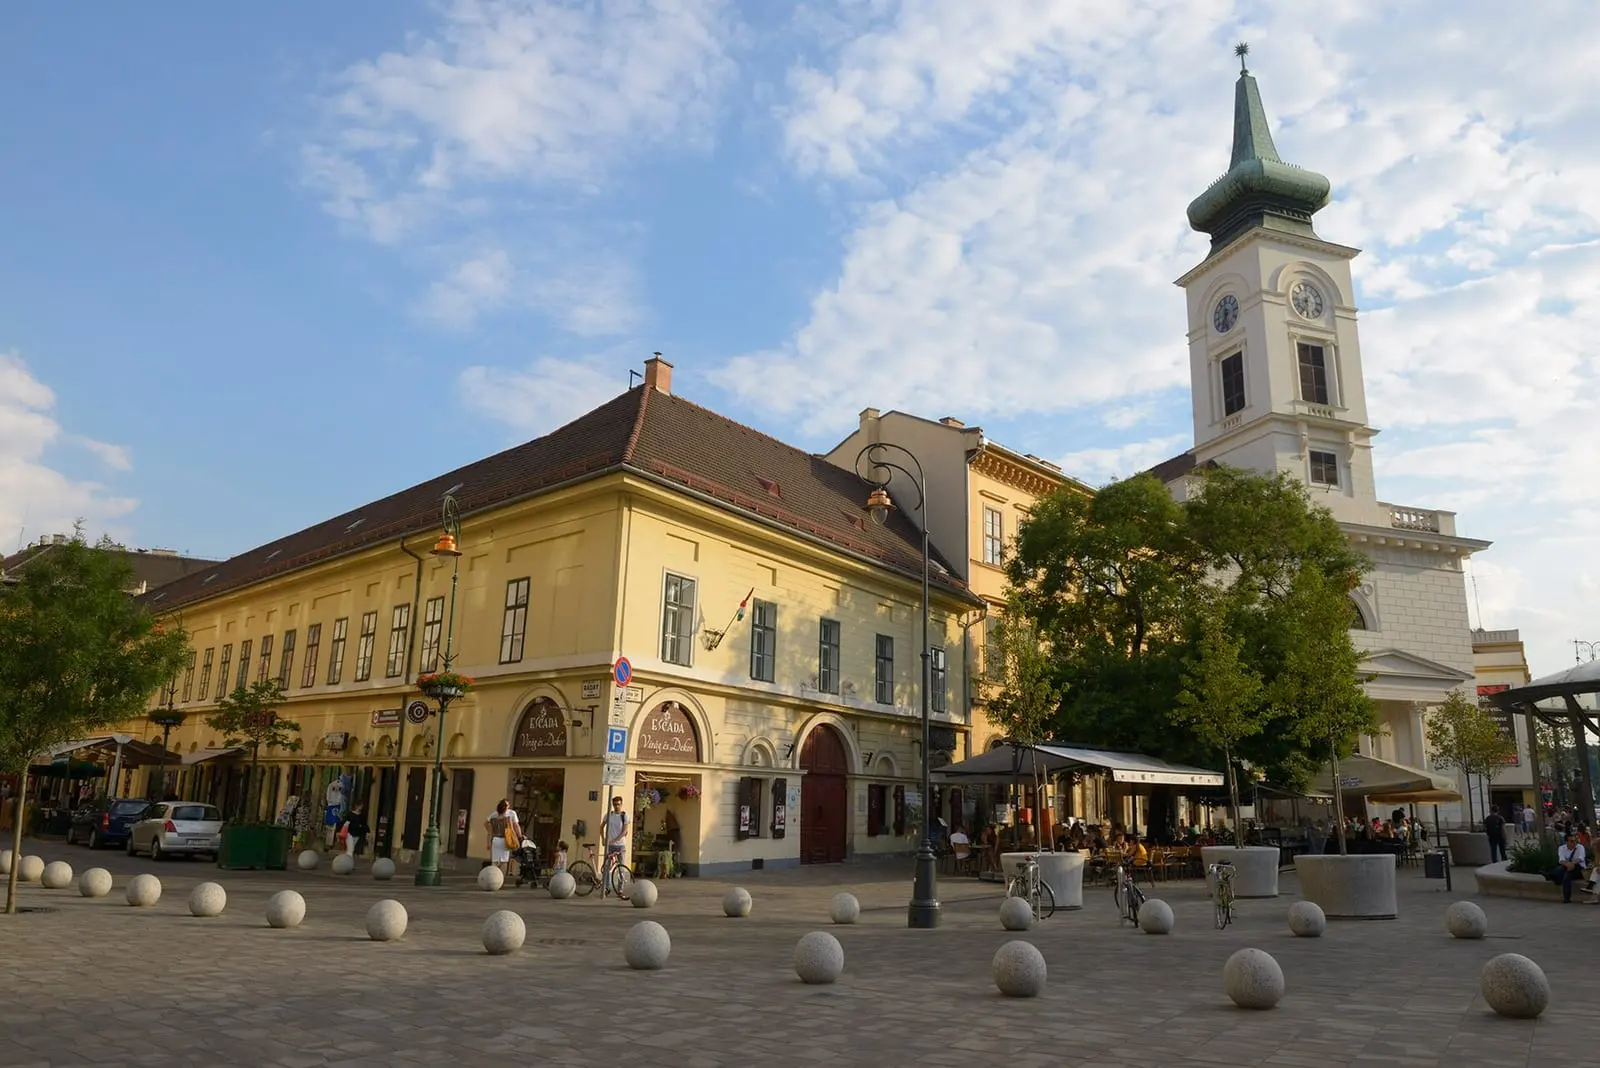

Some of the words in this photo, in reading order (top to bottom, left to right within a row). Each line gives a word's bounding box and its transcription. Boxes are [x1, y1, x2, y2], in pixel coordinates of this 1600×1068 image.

[530, 717, 559, 729] ESCADA
[651, 718, 685, 734] ESCADA
[612, 731, 623, 750] P
[641, 734, 662, 754] Virág
[670, 736, 694, 752] Dekor
